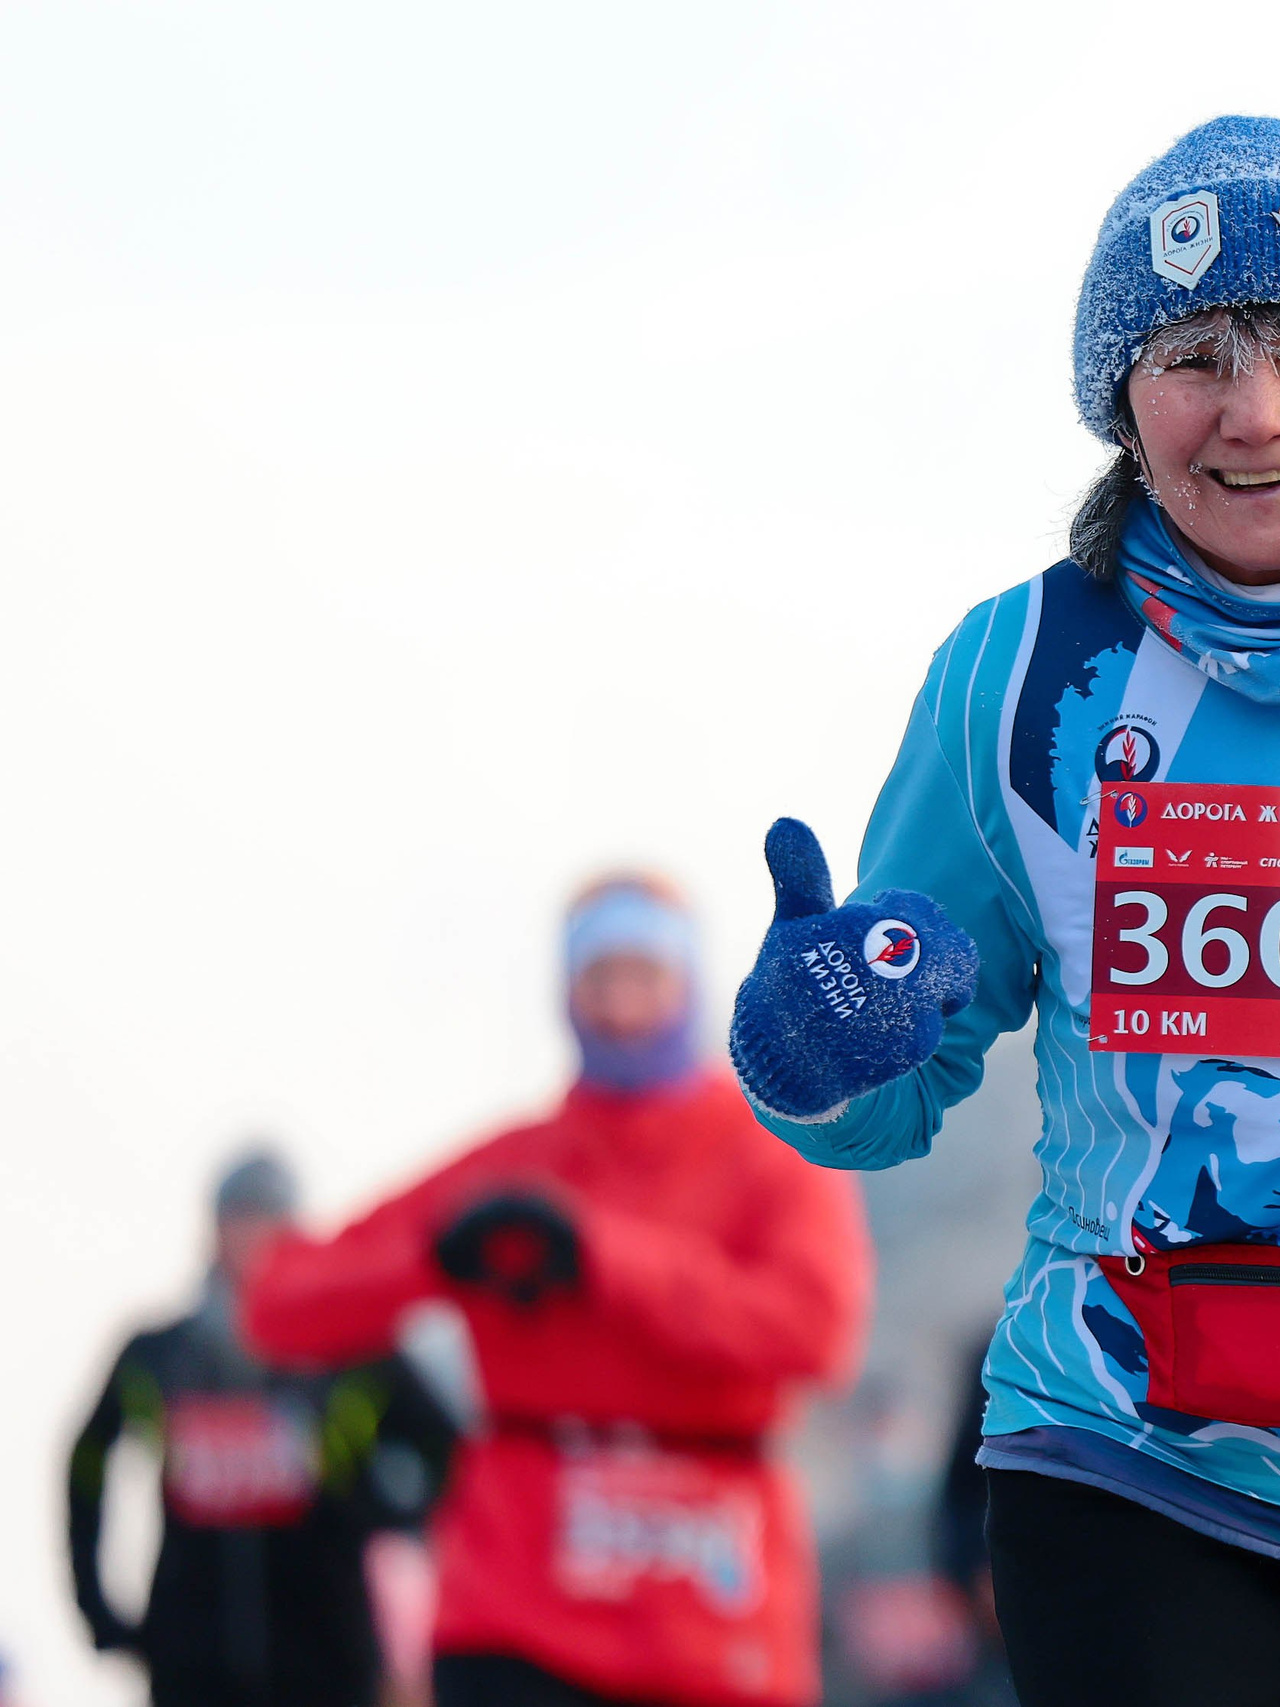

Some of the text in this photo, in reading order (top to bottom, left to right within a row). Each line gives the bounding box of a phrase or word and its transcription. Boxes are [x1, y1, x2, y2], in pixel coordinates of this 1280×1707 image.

[1126, 713, 1158, 727] МАРАФОН
[1160, 802, 1247, 823] ДОРОГА
[801, 949, 853, 1019] ЖИЗНИ
[818, 941, 867, 1009] ДОРОГА
[1113, 1009, 1151, 1036] 10
[1161, 1011, 1208, 1037] КМ
